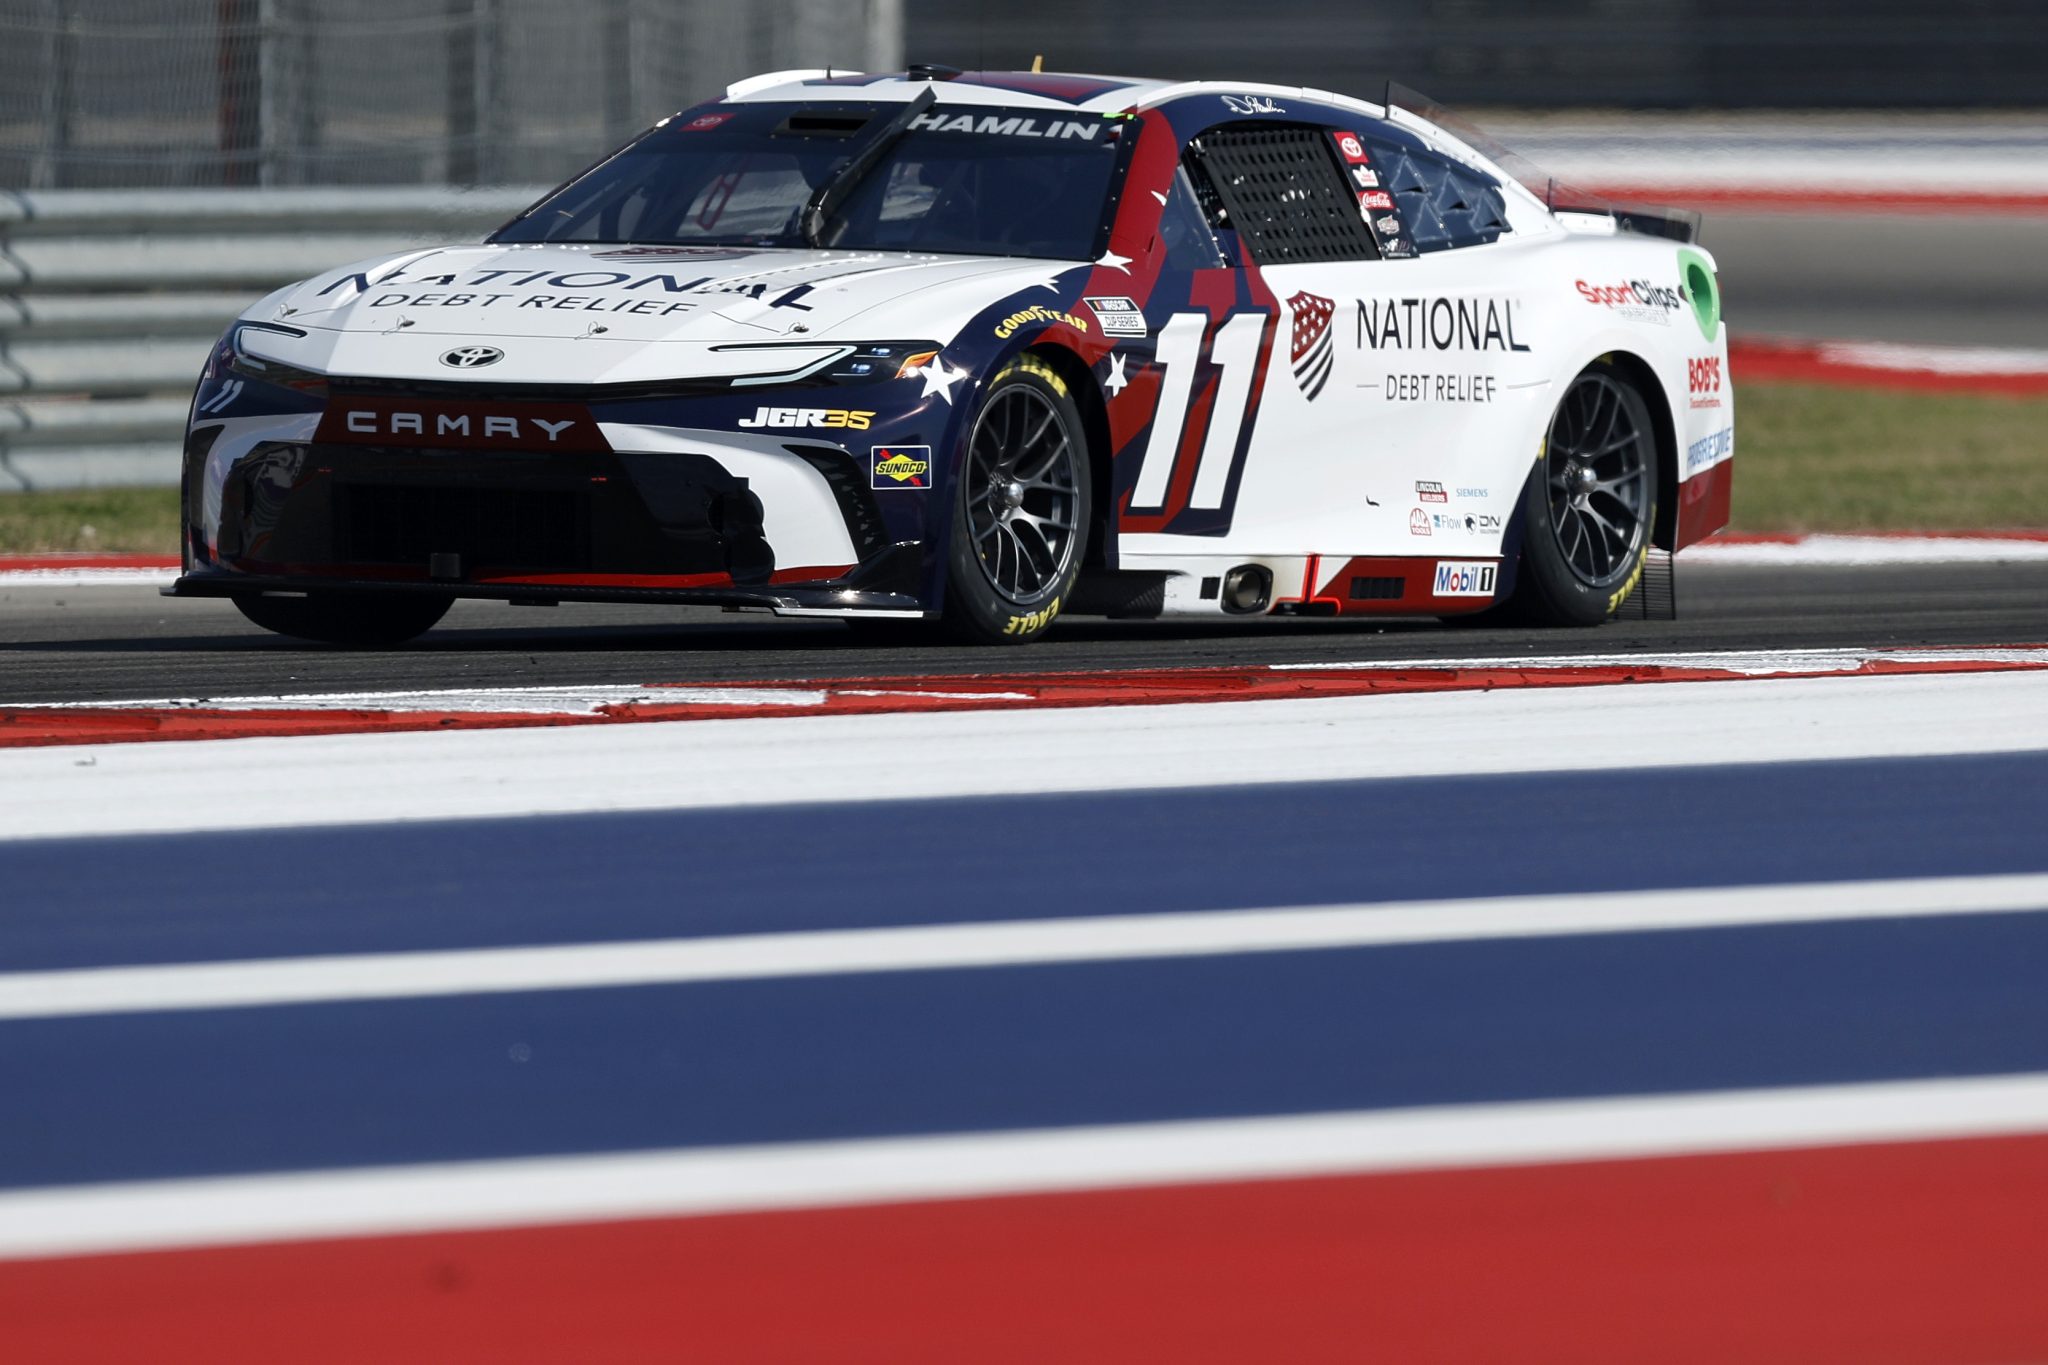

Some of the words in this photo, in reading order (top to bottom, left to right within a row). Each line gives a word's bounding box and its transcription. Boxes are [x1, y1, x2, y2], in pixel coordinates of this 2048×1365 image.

[907, 113, 1100, 141] HAMLIN
[369, 292, 514, 308] DEBT
[518, 295, 698, 317] RELIEF
[994, 305, 1088, 339] GOODYEAR
[1105, 315, 1117, 328] CUP
[1117, 315, 1139, 328] SERIES
[1356, 298, 1531, 352] NATIONAL
[1688, 356, 1720, 393] BOB'S
[1386, 375, 1430, 401] DEBT
[1436, 375, 1496, 402] RELIEF
[738, 406, 877, 430] JGR35
[1130, 313, 1267, 509] 11
[347, 411, 575, 441] CAMRY
[877, 462, 926, 474] SUNOCO
[1417, 482, 1441, 493] LINCOLN
[1456, 488, 1488, 498] SIEMENS
[1412, 527, 1430, 535] TOOLS
[1441, 514, 1462, 529] Flow
[1436, 566, 1479, 592] Mobil
[1481, 567, 1493, 592] 1
[1003, 596, 1060, 635] EAGLE
